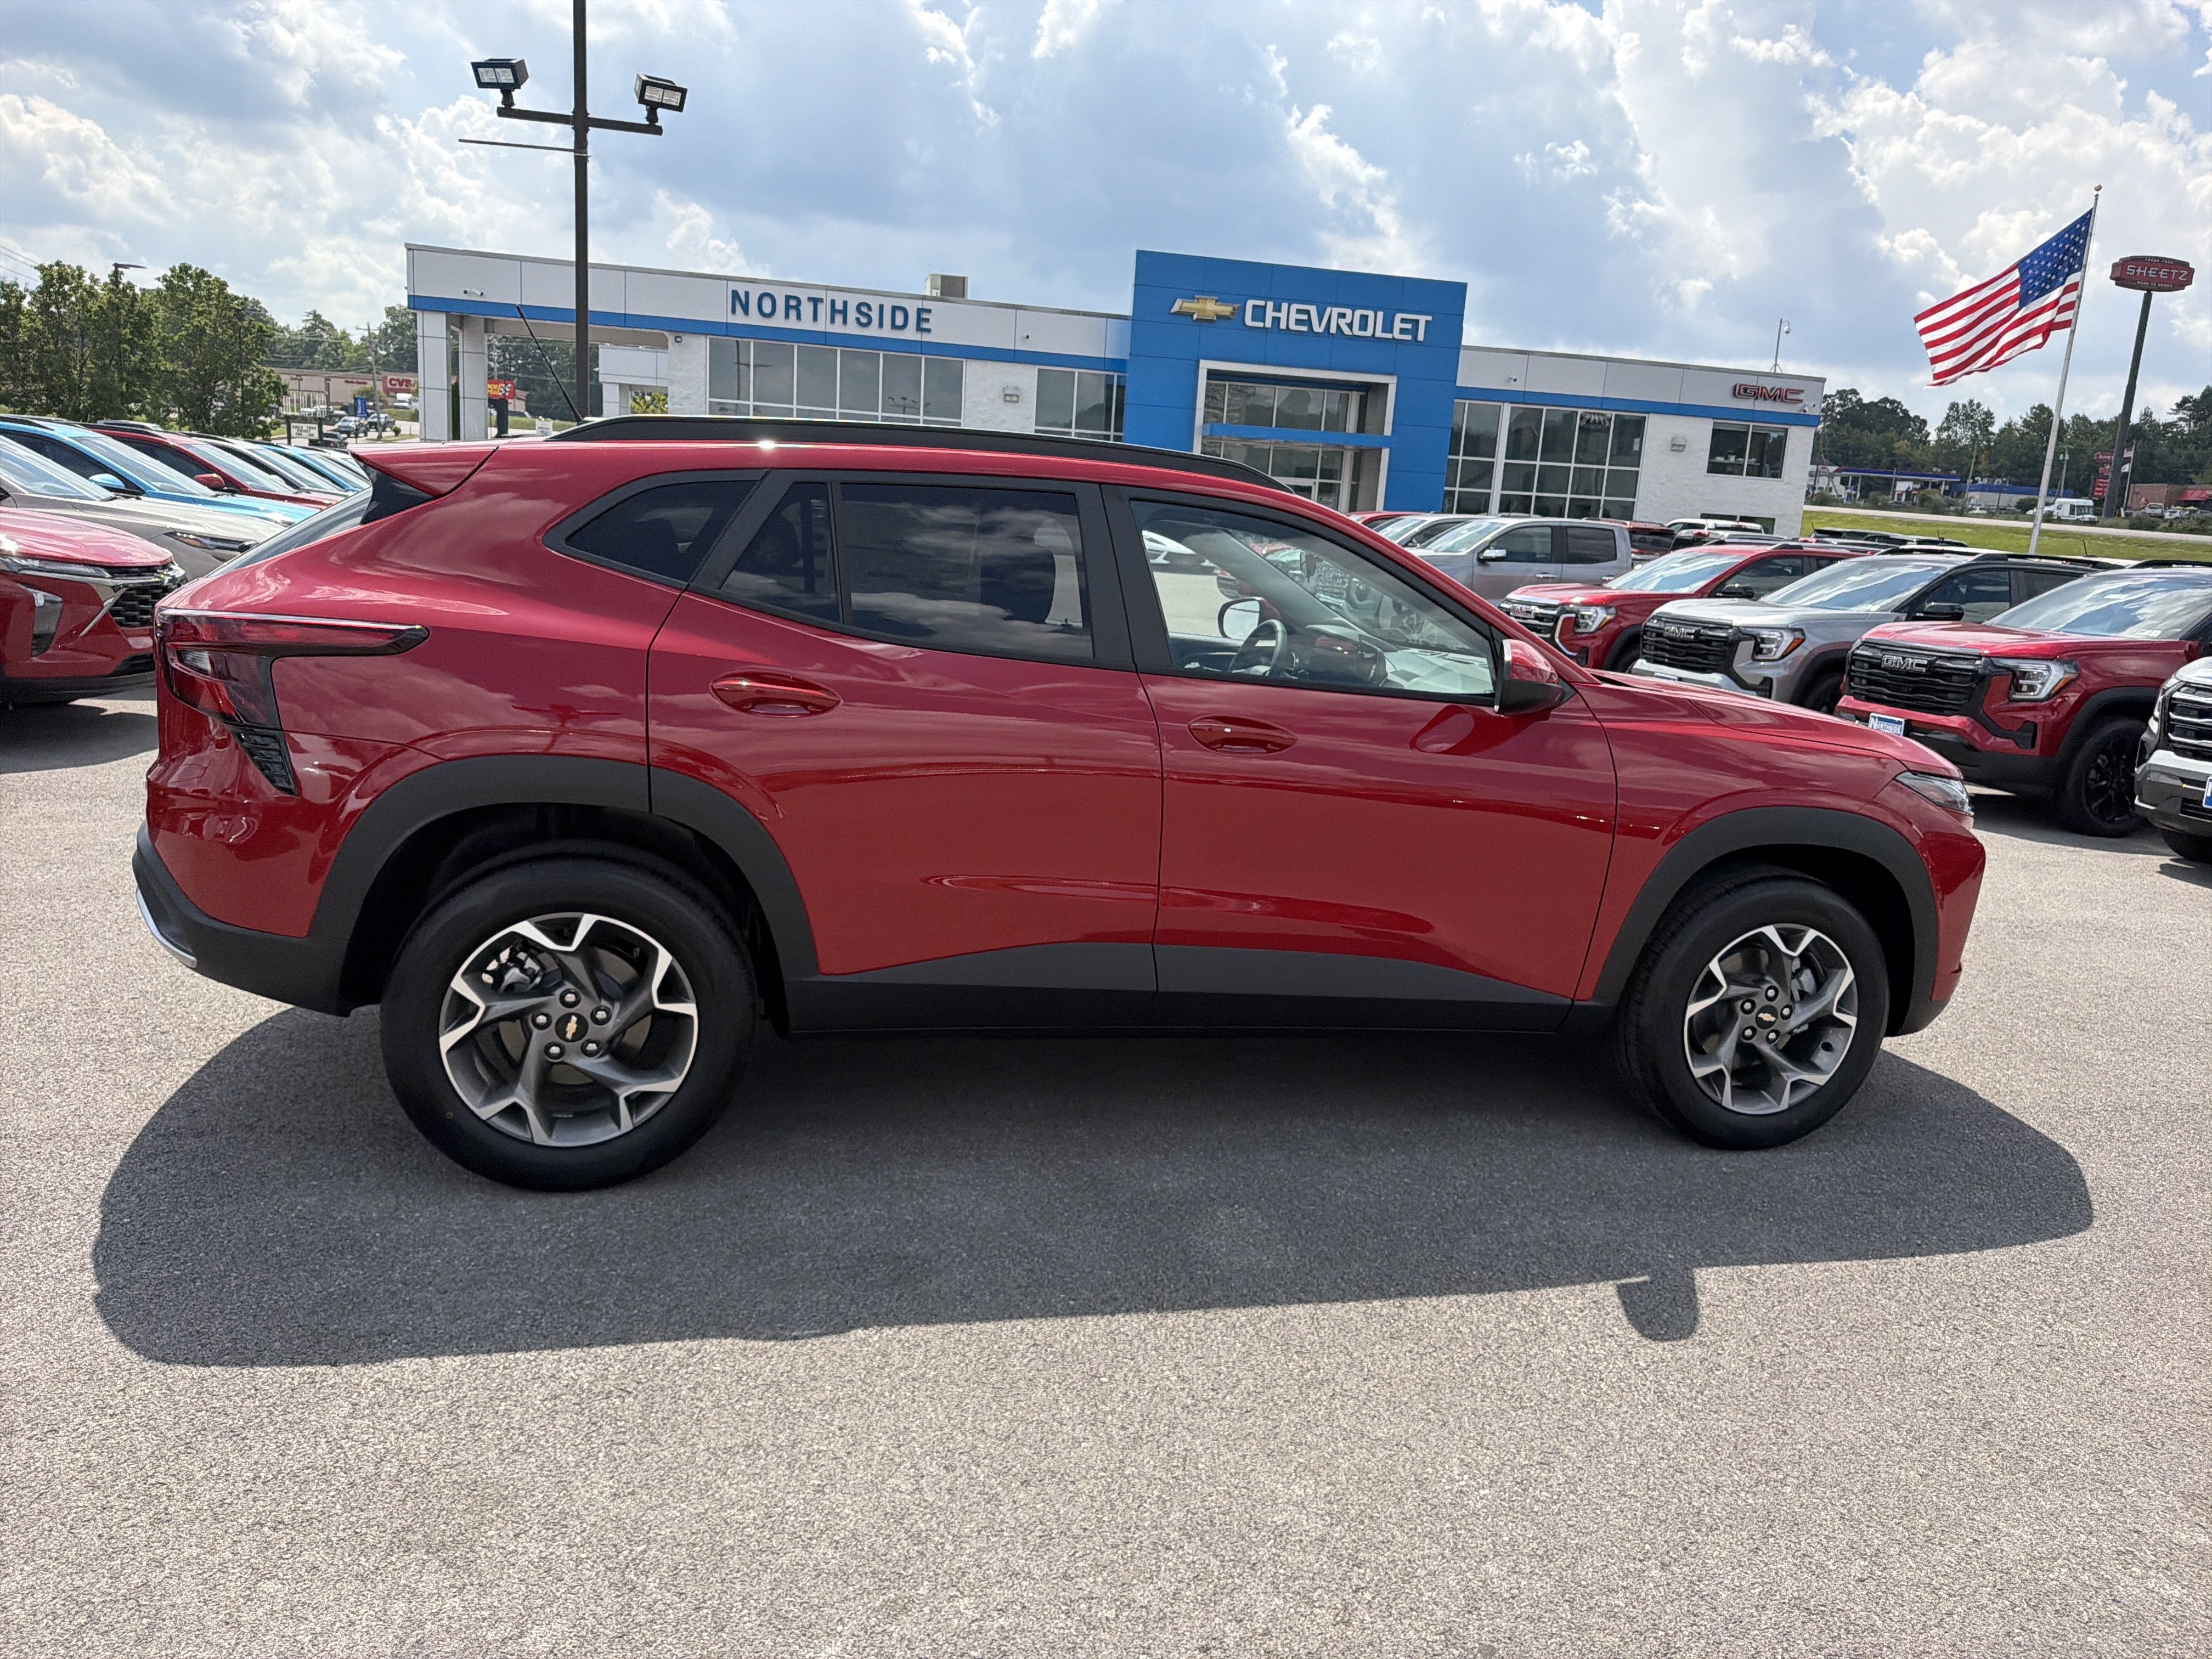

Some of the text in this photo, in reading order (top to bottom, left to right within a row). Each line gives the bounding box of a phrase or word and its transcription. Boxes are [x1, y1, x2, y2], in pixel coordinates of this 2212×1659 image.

[2126, 265, 2188, 280] SHEETZ
[731, 289, 932, 332] NORTHSIDE
[1245, 300, 1432, 341] CHEVROLET
[1733, 383, 1804, 403] GMC
[1511, 605, 1534, 618] GMC
[1663, 626, 1695, 640] GMC
[1881, 654, 1928, 673] GMC
[1870, 716, 1902, 735] NORTHSIDE
